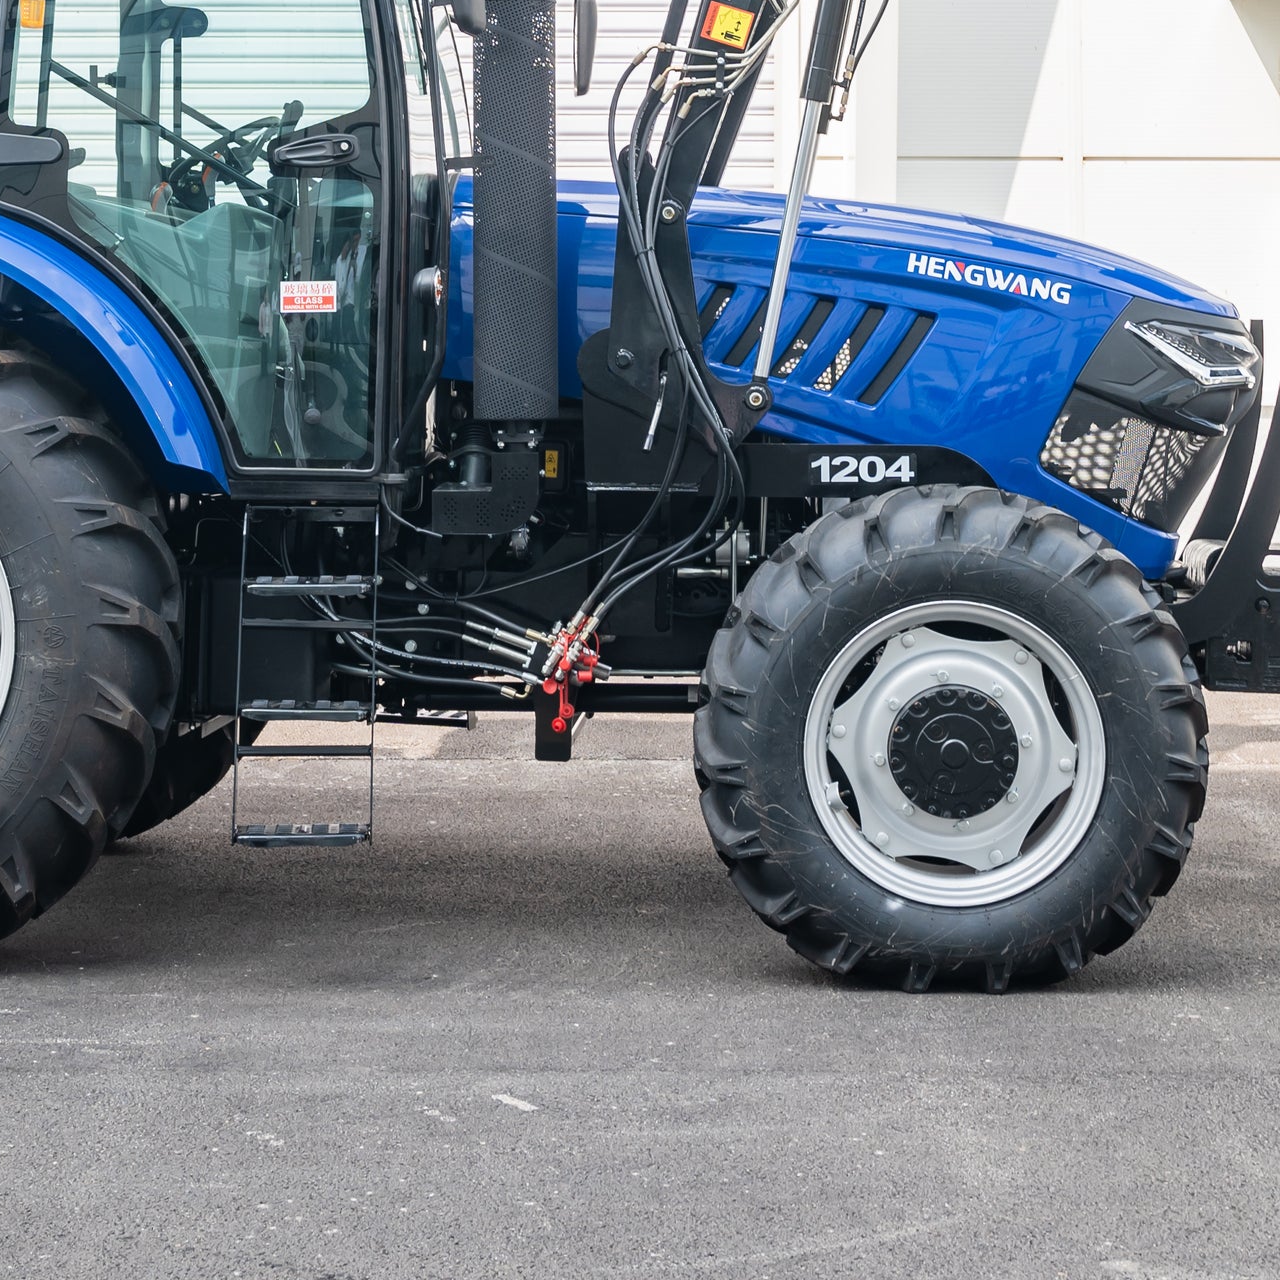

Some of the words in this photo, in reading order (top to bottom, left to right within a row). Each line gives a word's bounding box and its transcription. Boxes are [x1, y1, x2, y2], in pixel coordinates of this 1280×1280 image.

[284, 283, 333, 295] 玻璃易碎
[907, 253, 1072, 305] HENGWANG
[810, 455, 915, 483] 1204
[0, 665, 65, 798] TAISHAN
